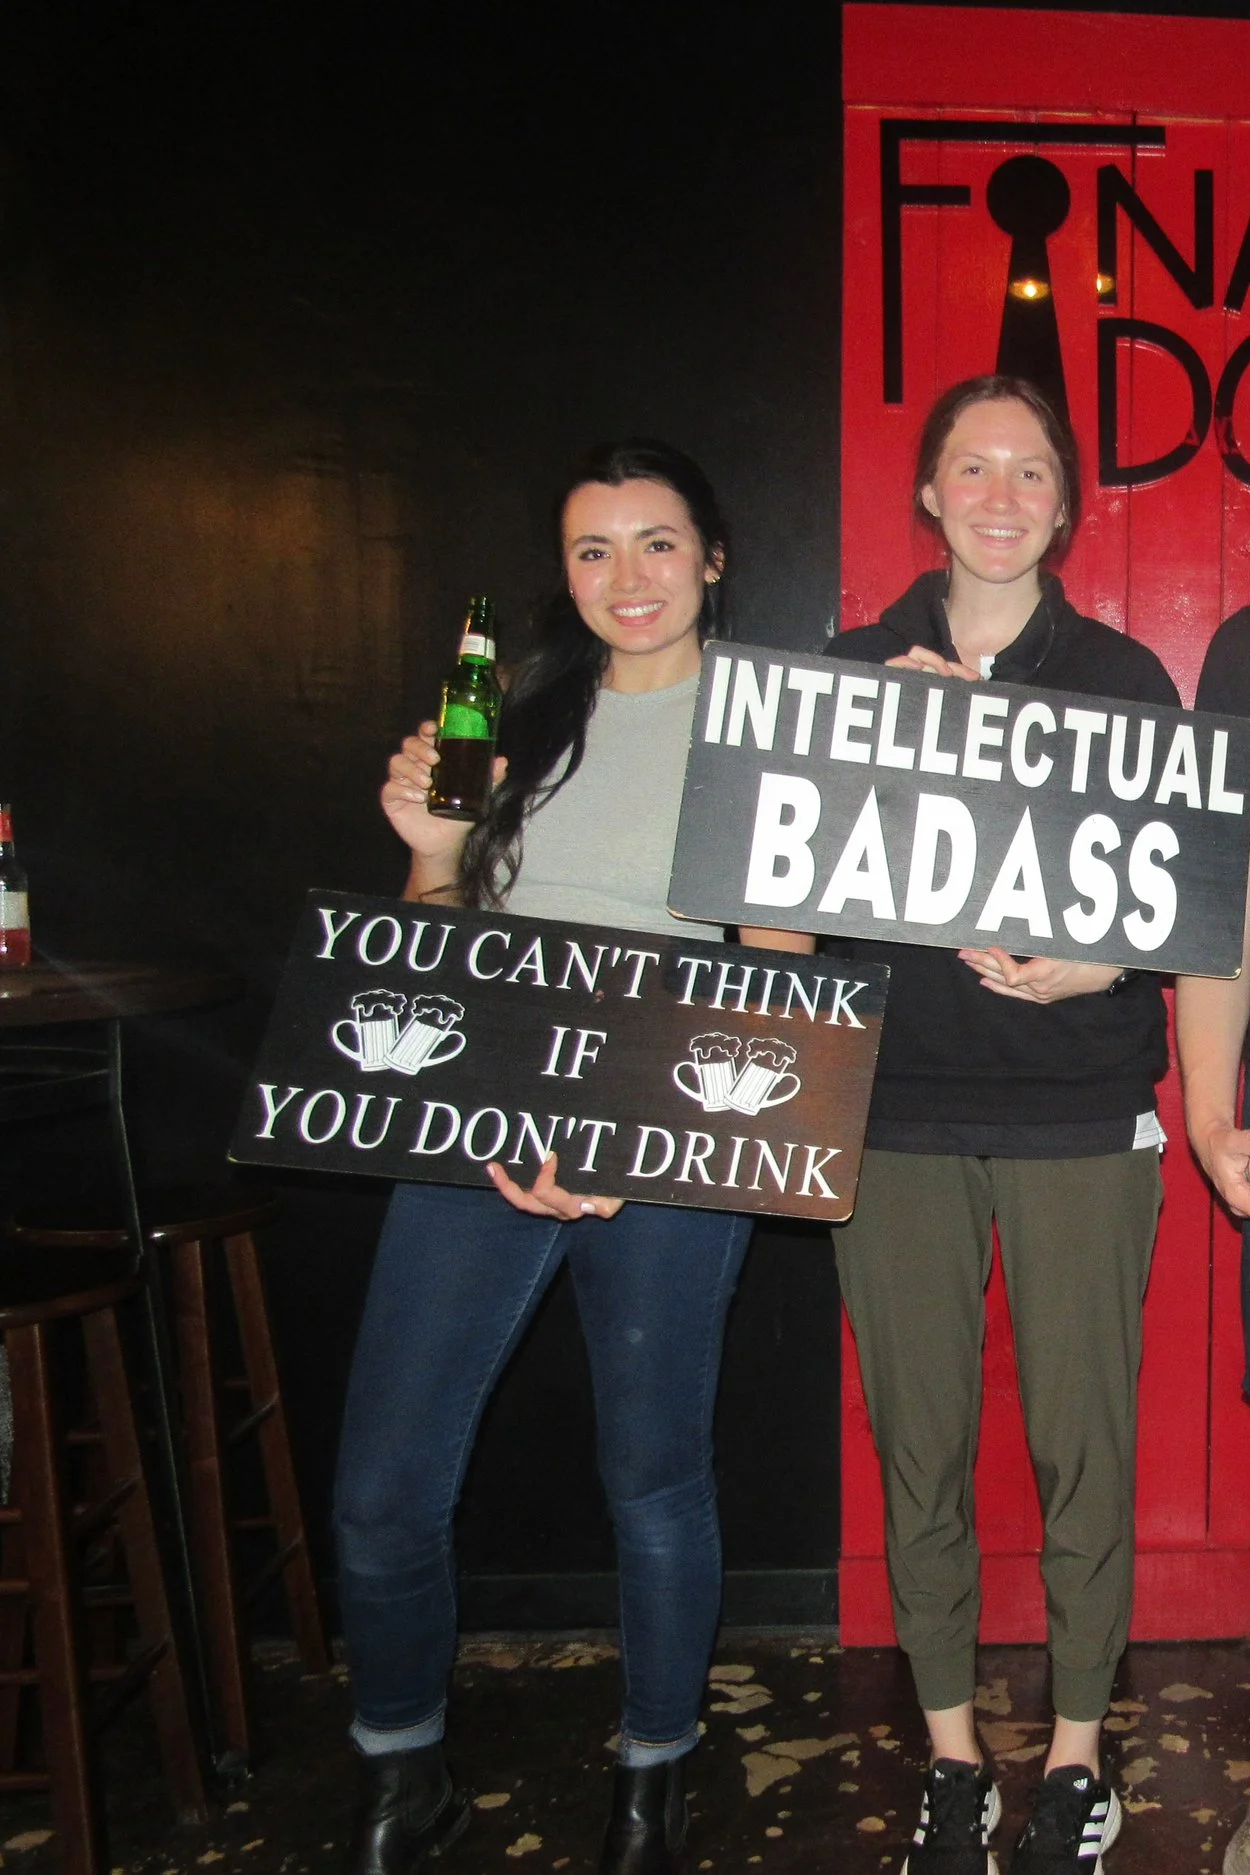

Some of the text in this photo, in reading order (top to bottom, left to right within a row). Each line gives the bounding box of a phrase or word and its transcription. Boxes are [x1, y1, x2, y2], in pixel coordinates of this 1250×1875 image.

[704, 655, 1245, 815] INTELLECTUAL
[743, 771, 1181, 953] BADASS
[315, 908, 870, 1031] YOU CAN'T THINK
[541, 1025, 608, 1080] IF
[254, 1083, 844, 1201] YOU DON'T DRINK
